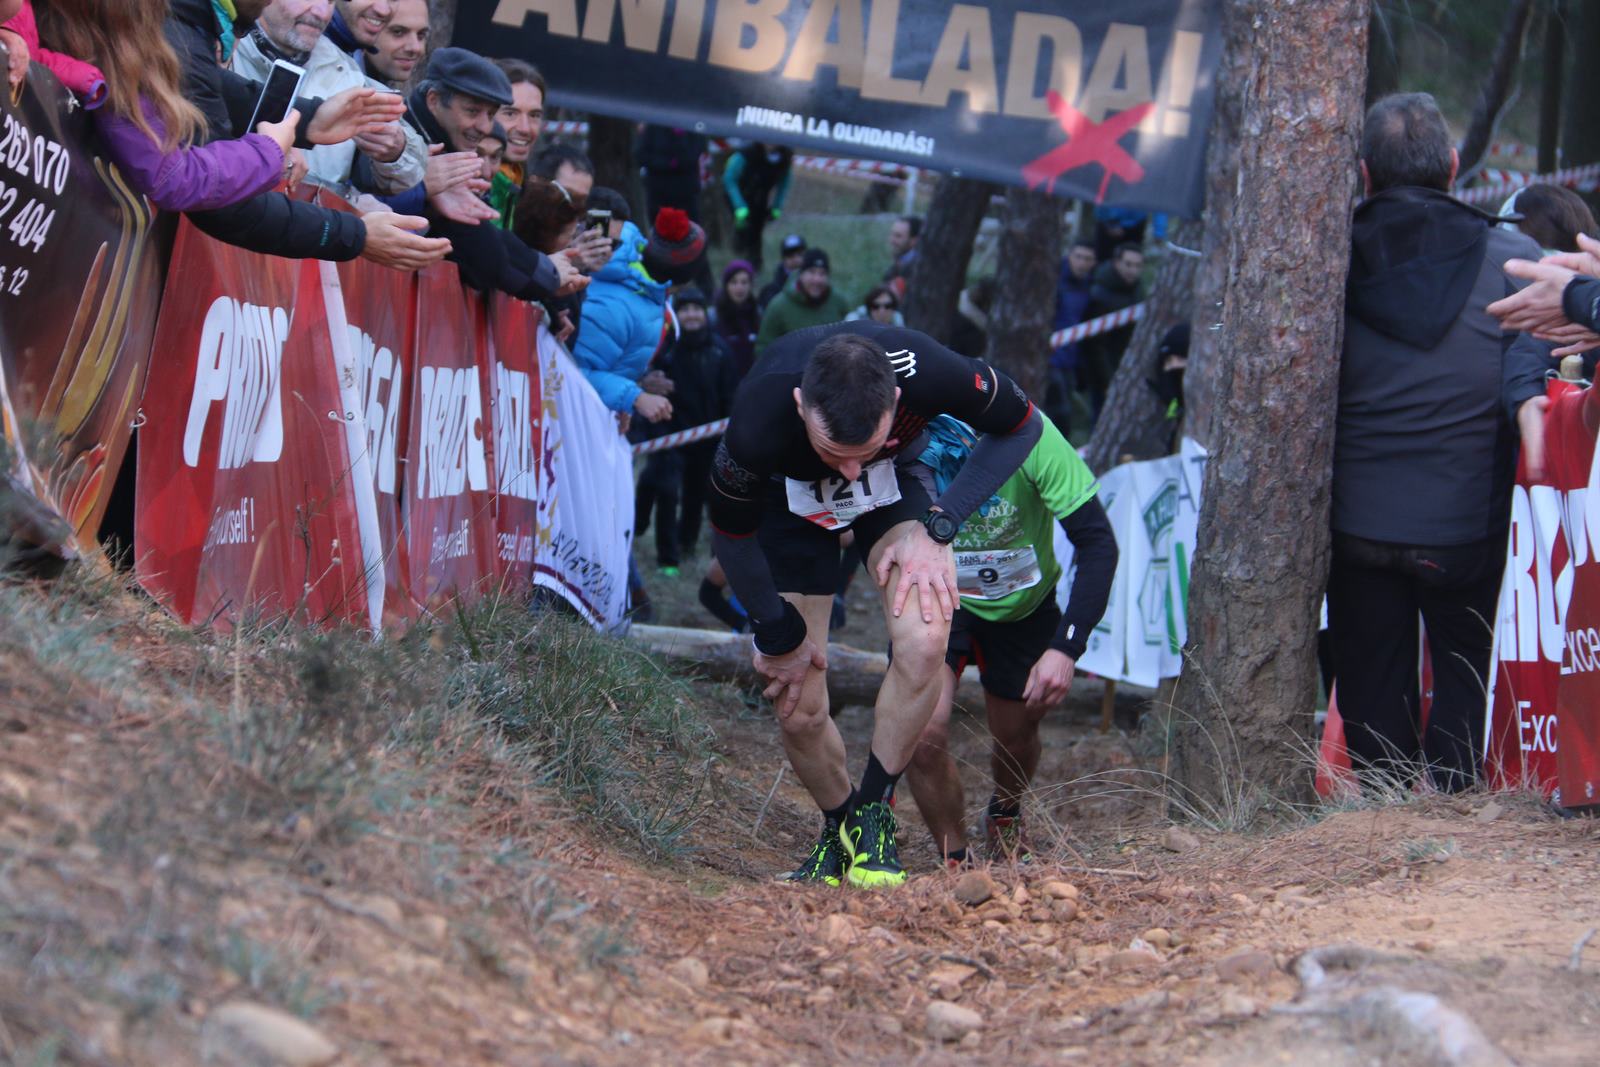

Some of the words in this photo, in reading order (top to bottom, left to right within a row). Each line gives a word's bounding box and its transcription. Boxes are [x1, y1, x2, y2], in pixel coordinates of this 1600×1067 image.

[736, 105, 803, 134] ¡NUNCA
[806, 117, 830, 138] LA
[832, 121, 935, 157] OLVIDARÁS!
[8, 199, 56, 253] 404
[8, 267, 29, 296] 12
[809, 470, 873, 504] 121
[835, 500, 854, 509] PACO
[978, 567, 999, 584] 9
